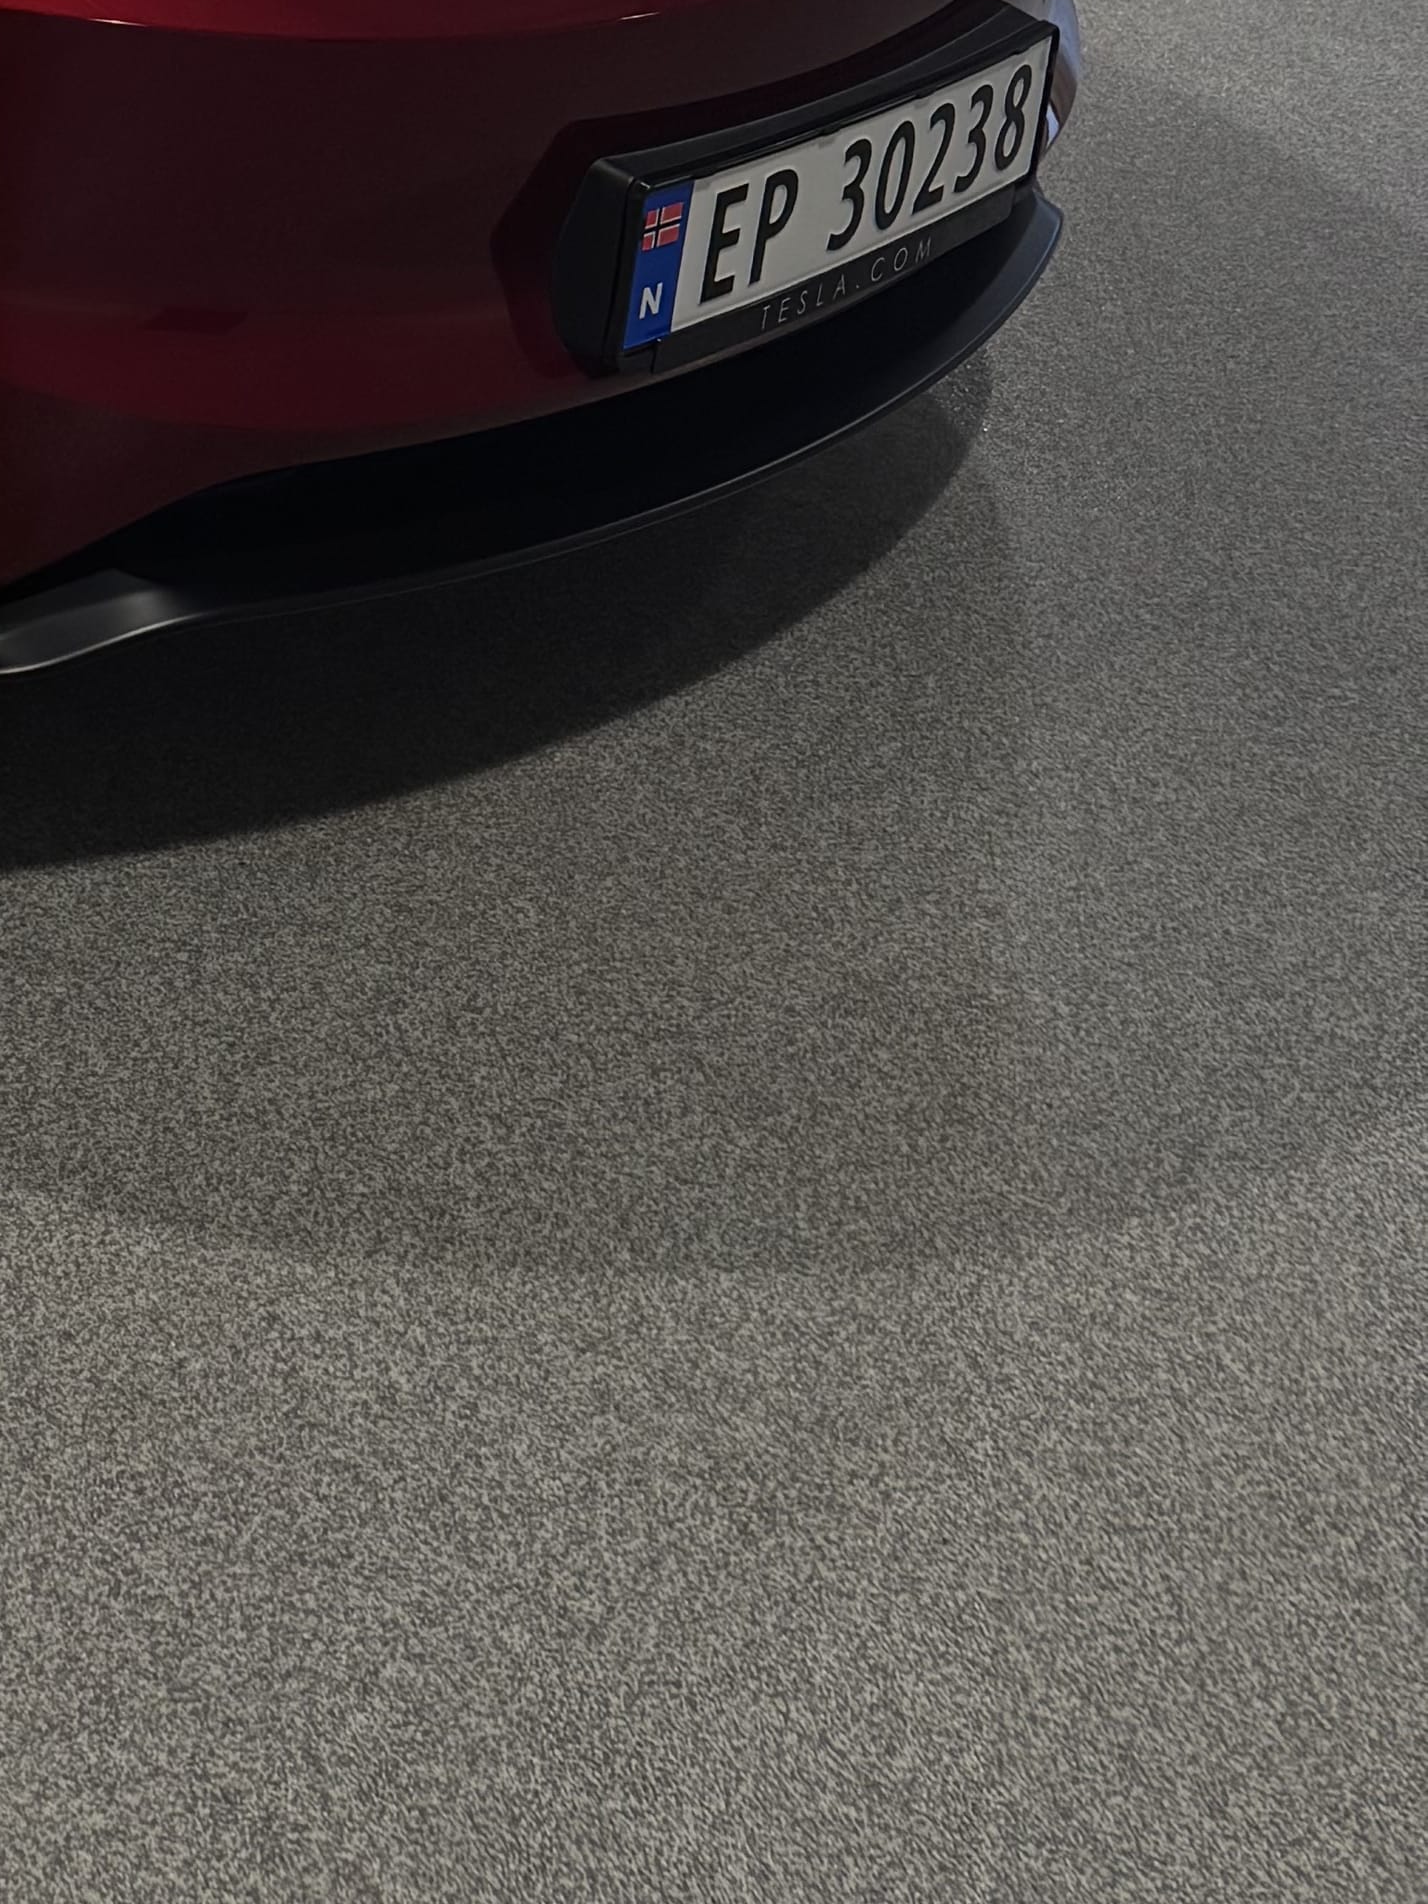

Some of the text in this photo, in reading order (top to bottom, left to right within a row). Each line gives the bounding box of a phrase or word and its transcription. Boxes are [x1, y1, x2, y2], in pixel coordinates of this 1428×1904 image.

[699, 64, 1033, 305] EP 30238
[639, 281, 664, 319] N
[759, 238, 934, 331] TESLA.COM
